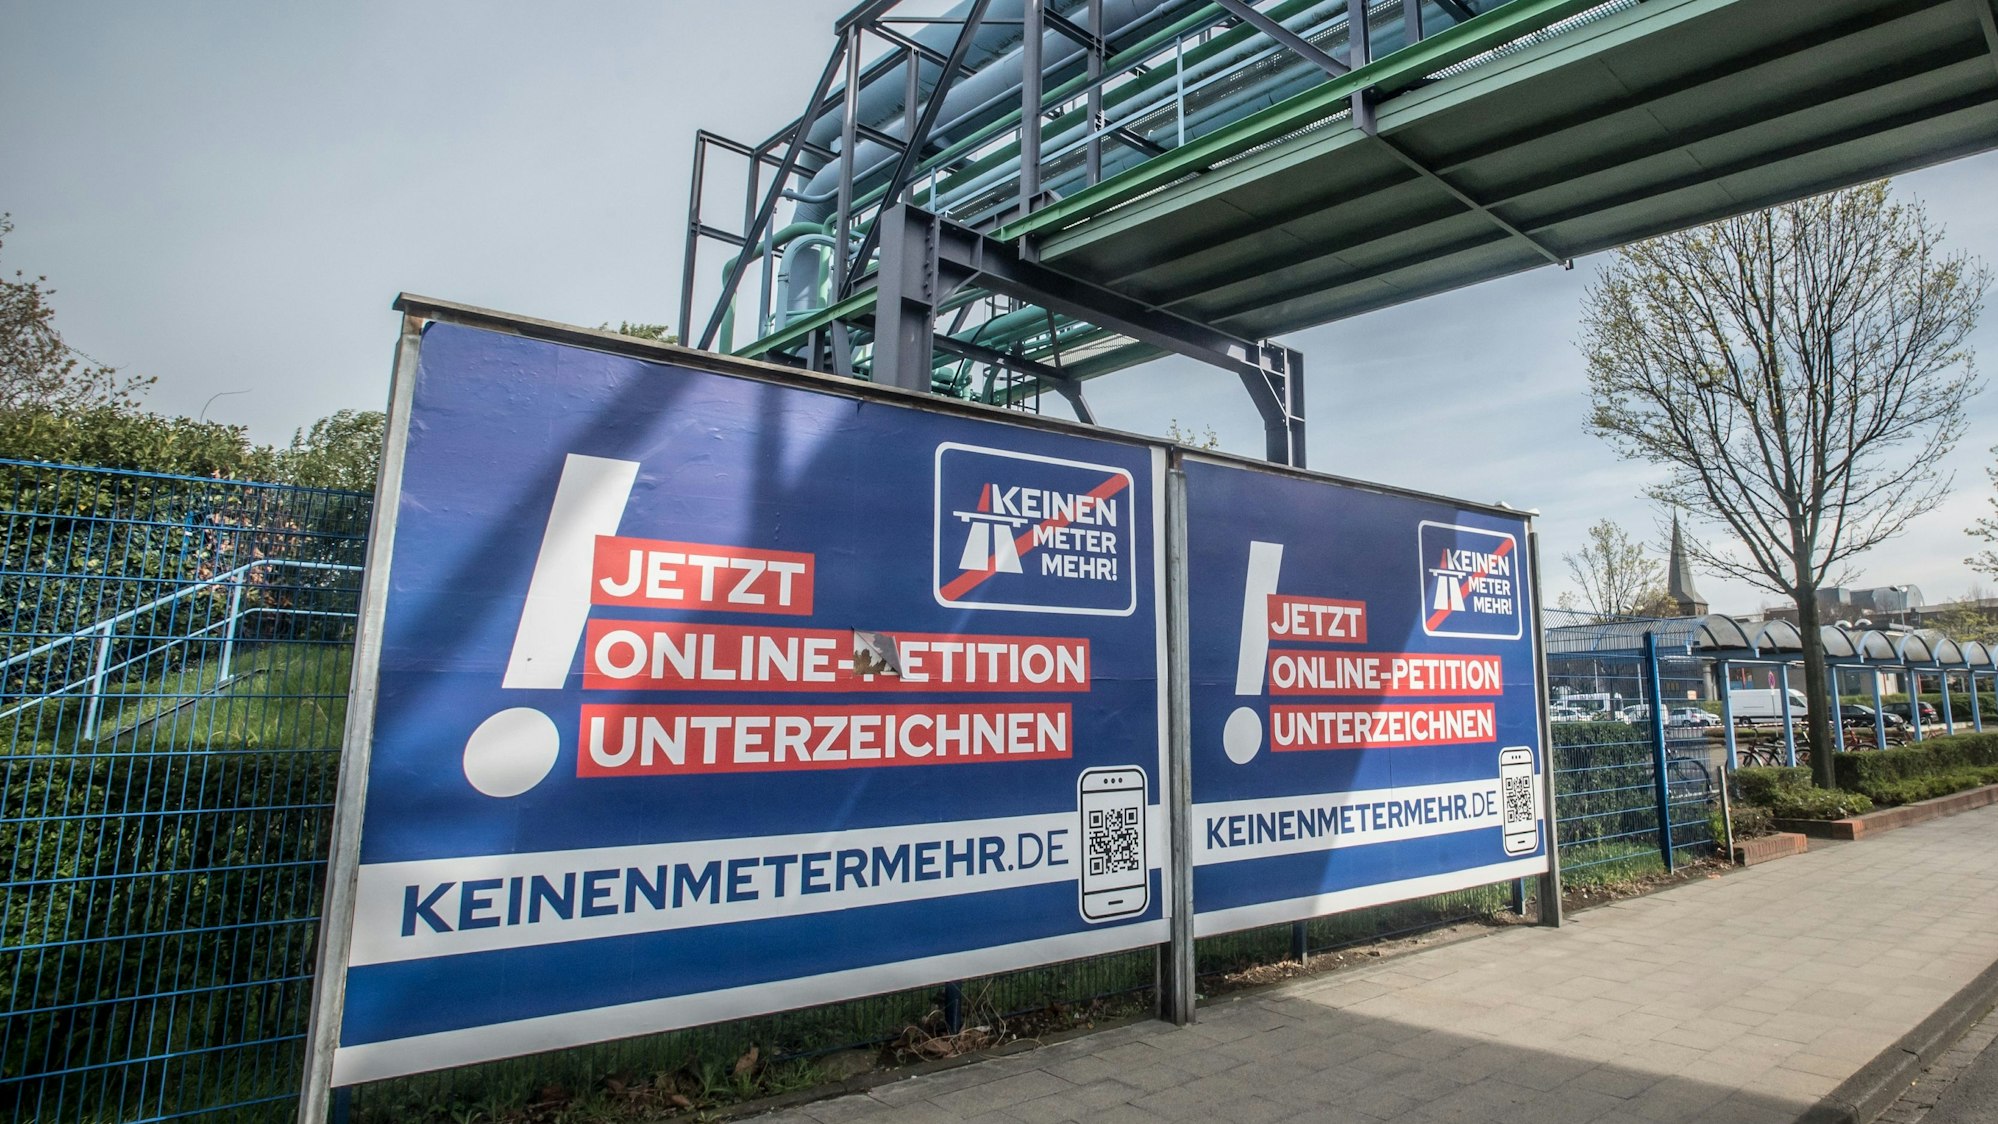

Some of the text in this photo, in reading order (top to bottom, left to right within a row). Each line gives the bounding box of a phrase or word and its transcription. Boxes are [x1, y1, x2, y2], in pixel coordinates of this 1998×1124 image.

[992, 483, 1117, 527] KEINEN
[1033, 524, 1117, 554] METER
[599, 549, 806, 606] JETZT
[1041, 553, 1118, 582] MEHR!
[1446, 548, 1510, 577] KEINEN
[1468, 576, 1511, 596] METER
[1271, 602, 1362, 638] JETZT
[1473, 596, 1512, 615] MEHR!
[594, 630, 1085, 683] ONLINE-ETITION
[1272, 656, 1500, 690] ONLINE-PETITION
[589, 712, 1067, 768] UNTERZEICHNEN
[1273, 709, 1494, 746] UNTERZEICHNEN
[1207, 790, 1497, 850] KEINENMETERMEHR.DE
[401, 829, 1070, 937] KEINENMETERMEHR.DE
